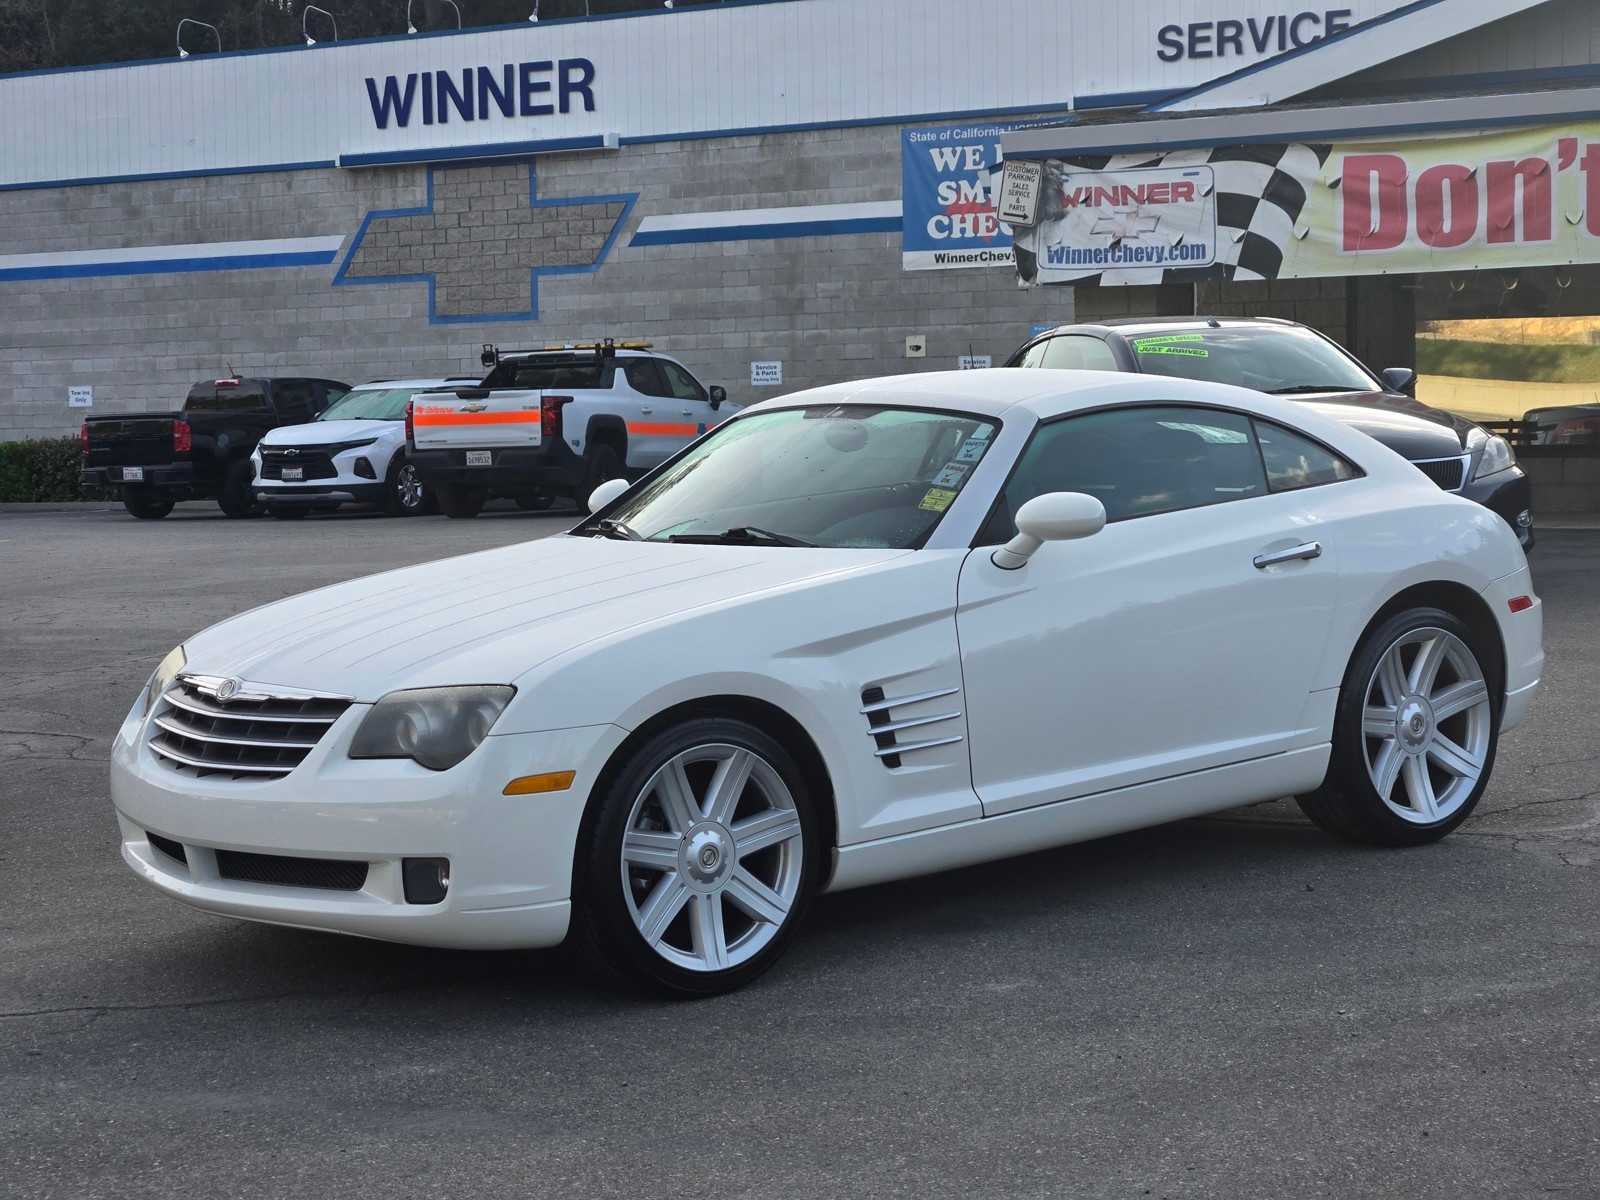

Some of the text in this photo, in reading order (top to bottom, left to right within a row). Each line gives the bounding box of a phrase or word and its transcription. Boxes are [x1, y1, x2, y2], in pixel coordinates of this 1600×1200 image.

[1156, 8, 1352, 63] SERVICE
[364, 57, 596, 130] WINNER
[910, 127, 1004, 142] State of California
[929, 144, 985, 172] WE
[1006, 164, 1040, 175] CUSTOMER
[1008, 172, 1036, 182] PARKING
[1008, 189, 1031, 198] SERVICE
[1012, 182, 1029, 190] SALES
[1060, 181, 1195, 208] WINNER
[1009, 203, 1026, 212] PARTS
[1047, 243, 1206, 265] WinnerChevy.com
